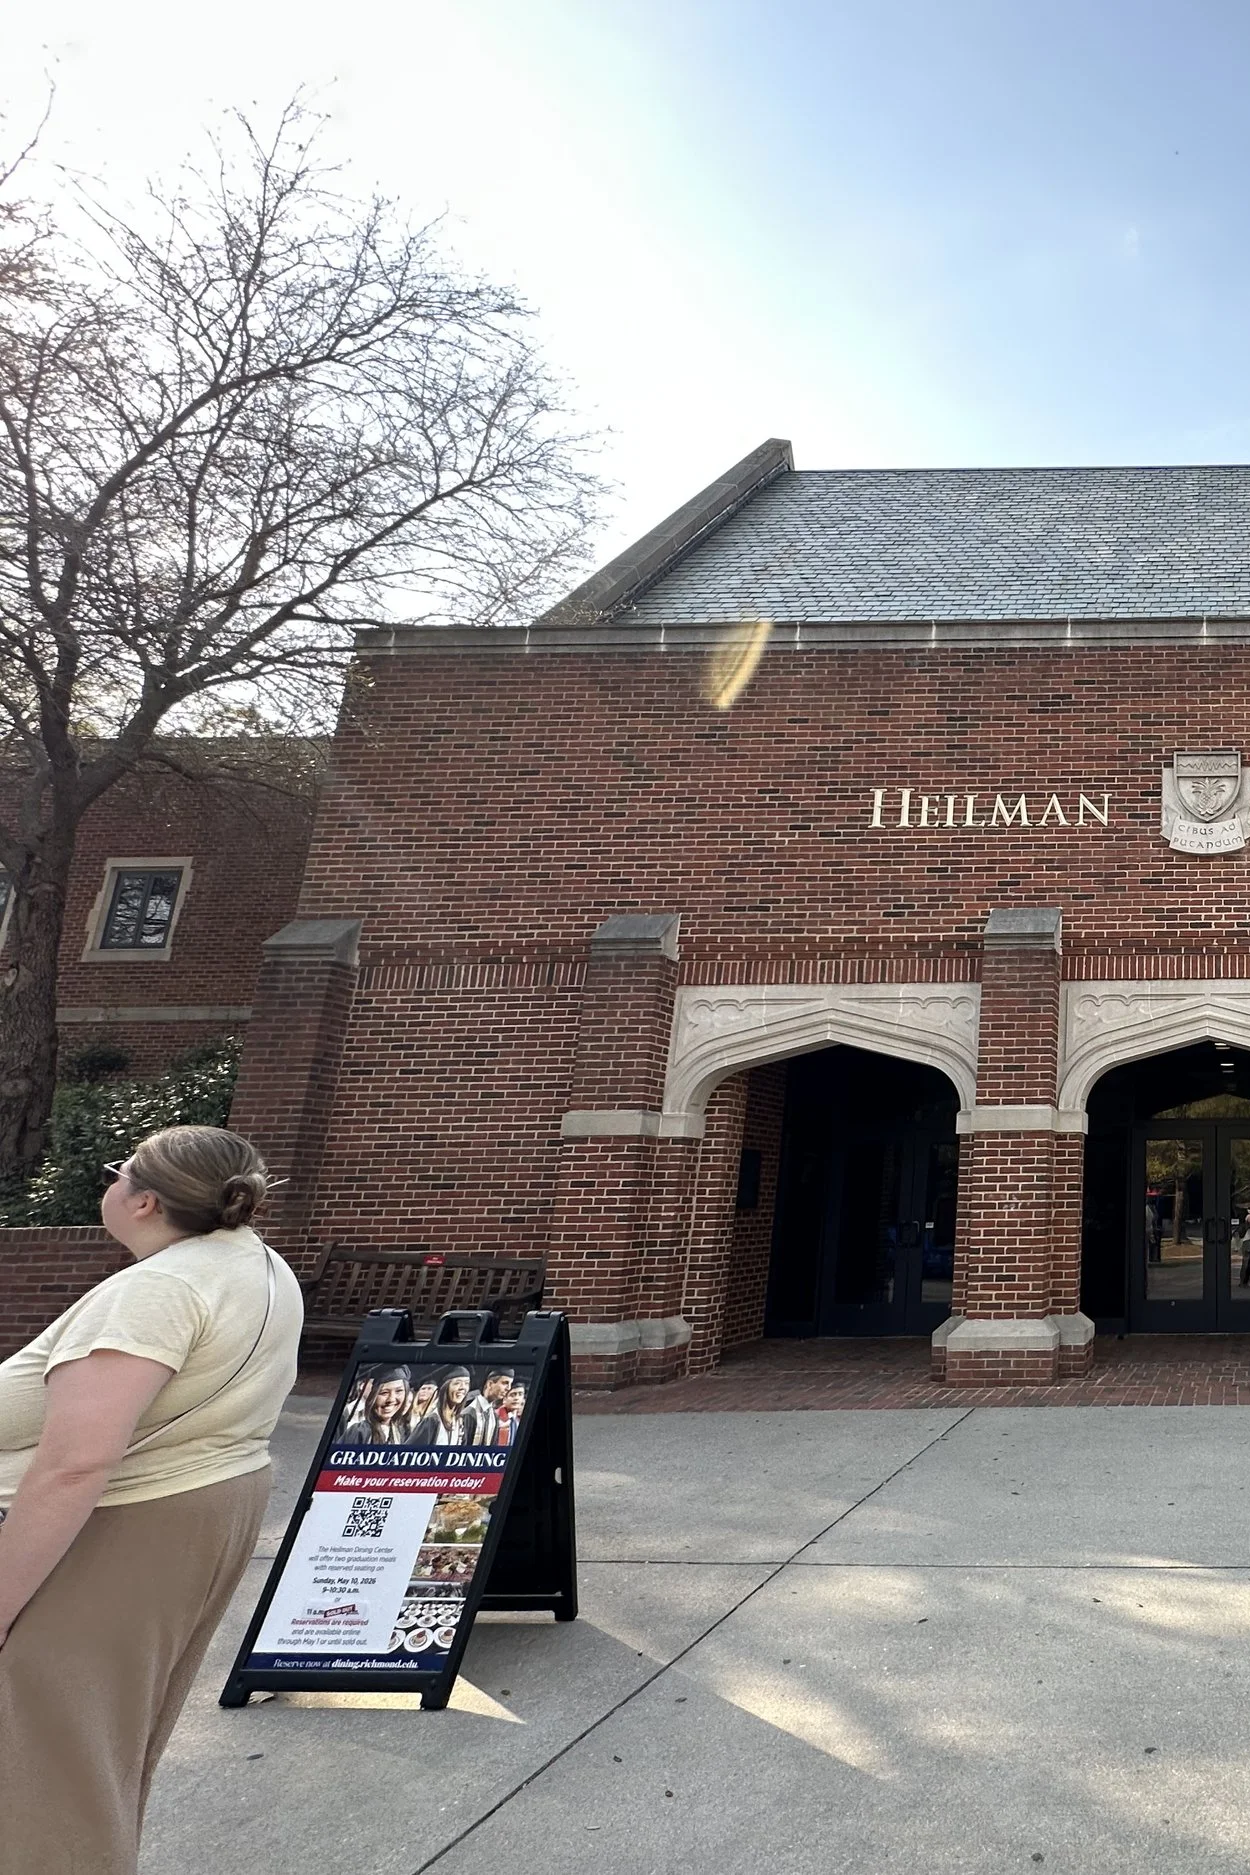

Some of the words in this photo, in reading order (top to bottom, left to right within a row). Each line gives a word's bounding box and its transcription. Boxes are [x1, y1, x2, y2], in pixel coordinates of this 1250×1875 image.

[867, 788, 1112, 829] HEILMAN
[1178, 824, 1213, 835] CIBUS
[330, 1450, 442, 1467] GRADUATION
[445, 1452, 506, 1467] DINING
[333, 1475, 363, 1487] Make
[362, 1477, 389, 1488] your
[390, 1475, 448, 1488] reservation
[450, 1477, 485, 1489] today!
[354, 1546, 373, 1554] Dining
[313, 1577, 336, 1585] Sunday,
[277, 1638, 301, 1646] through
[273, 1659, 305, 1668] Reserve
[331, 1659, 419, 1670] dining.richmond.edu
